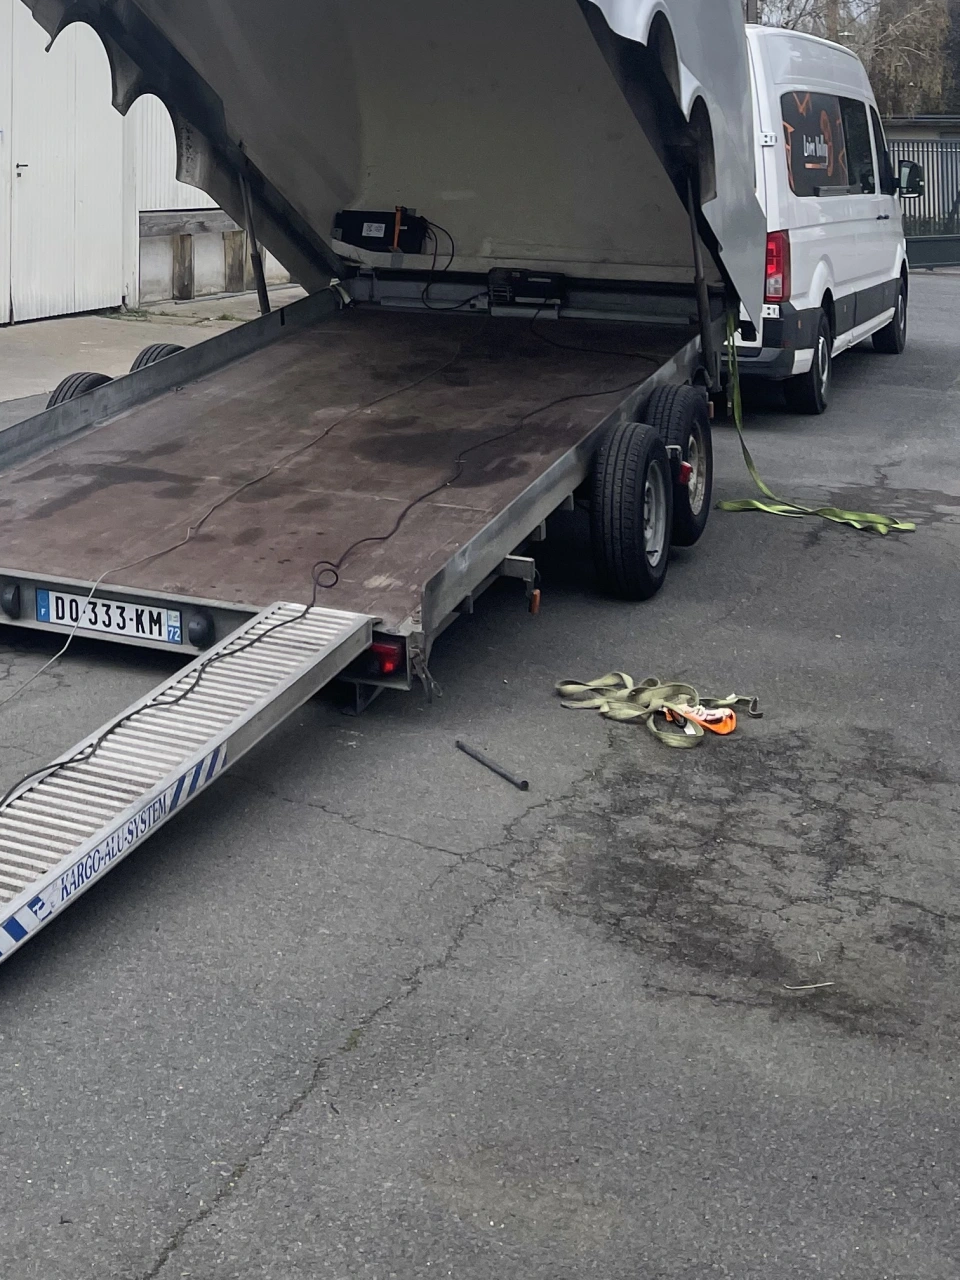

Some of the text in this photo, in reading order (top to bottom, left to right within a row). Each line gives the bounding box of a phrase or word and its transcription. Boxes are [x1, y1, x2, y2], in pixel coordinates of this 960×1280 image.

[41, 608, 46, 616] F
[167, 627, 181, 641] 72
[60, 792, 167, 902] KARGO-ALU-SYSTEM
